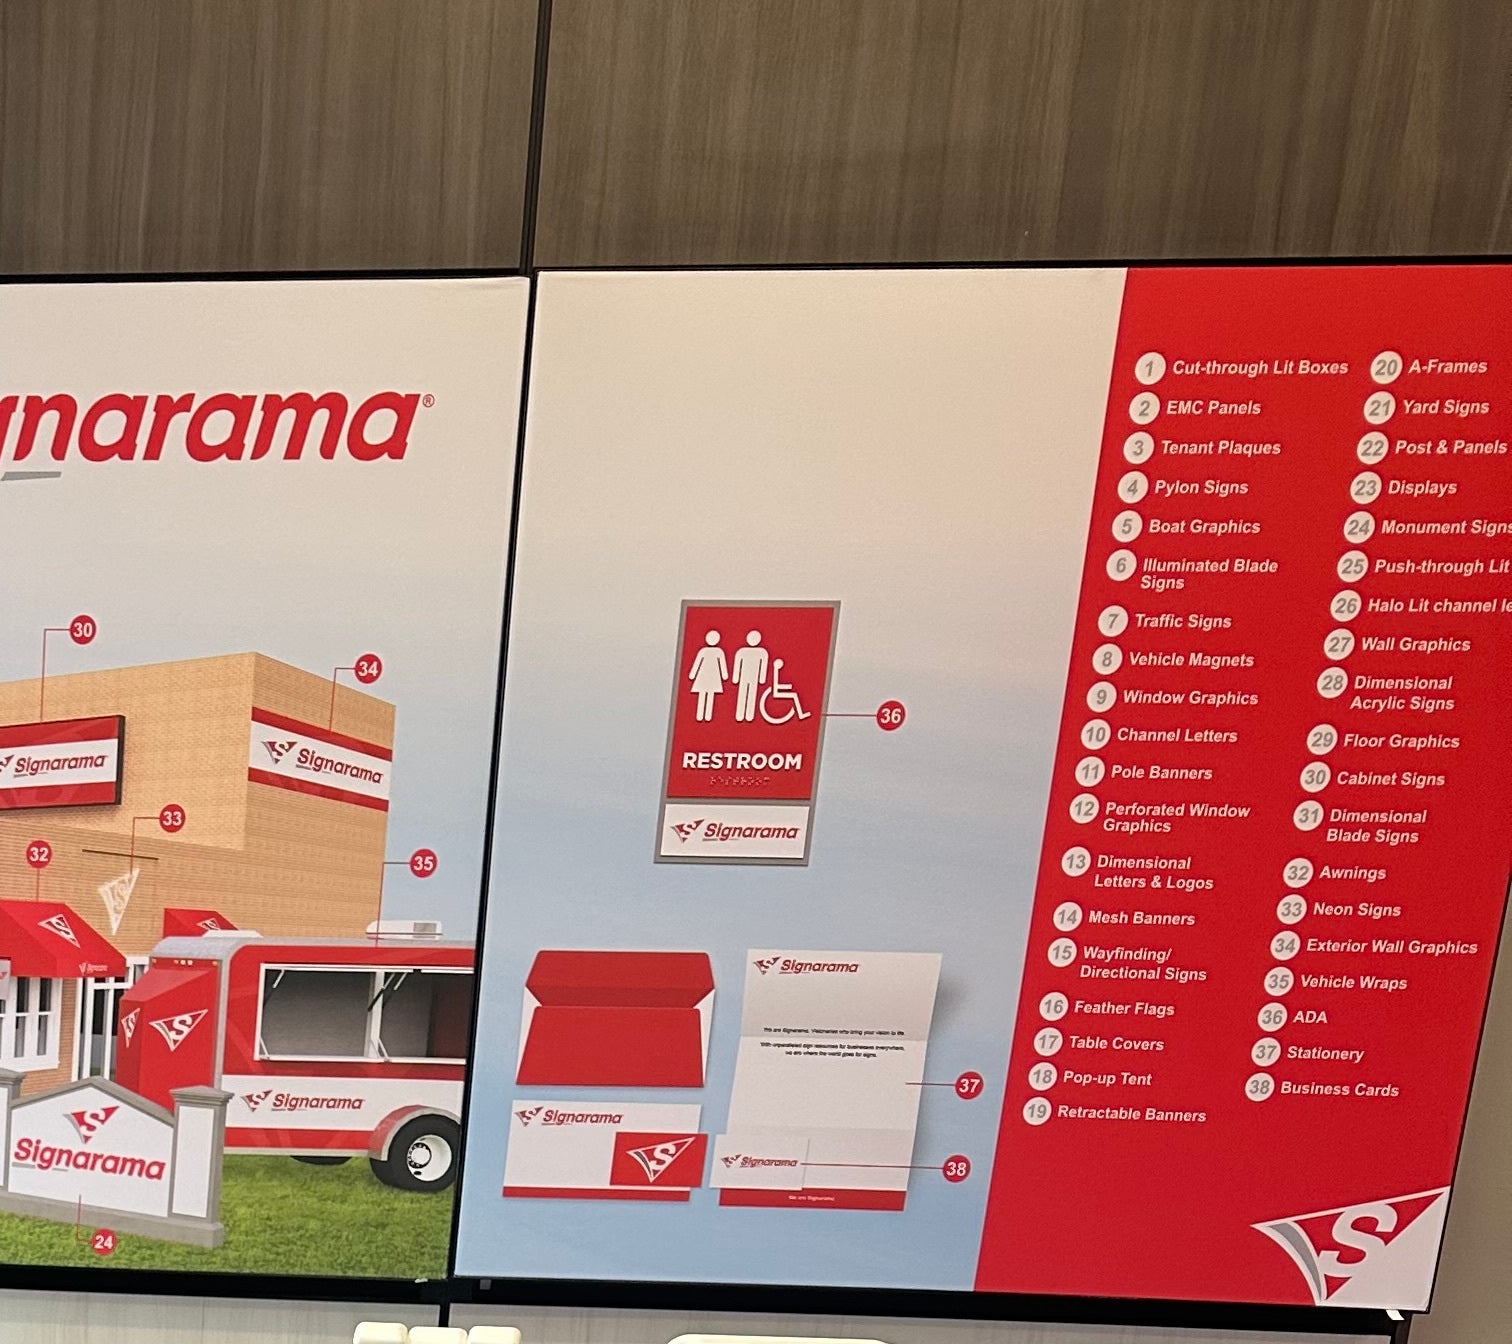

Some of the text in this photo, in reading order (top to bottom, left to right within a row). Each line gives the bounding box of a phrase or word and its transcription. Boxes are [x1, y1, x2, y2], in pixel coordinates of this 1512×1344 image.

[1173, 360, 1348, 378] Cut-through Lit Boxes
[1408, 359, 1487, 374] A-Frames
[1166, 400, 1261, 415] EMC Panels
[1403, 399, 1489, 417] Yard Signs
[1161, 440, 1281, 458] Tenant Plaques
[1395, 440, 1507, 454] Post & Panels
[1155, 480, 1248, 498] Pylon Signs
[1388, 480, 1457, 498] Displays
[1149, 519, 1260, 536] Boat Graphics
[1381, 519, 1512, 537] Monument Signs
[1143, 558, 1278, 573] Illuminated Blade
[1374, 559, 1510, 577] Push-through Lit
[1140, 575, 1184, 592] Signs
[1368, 598, 1497, 612] Halo Lit channel
[1135, 613, 1231, 631] Traffic Signs
[1362, 637, 1470, 654] Wall Graphics
[1130, 652, 1254, 670] Vehicle Magnets
[1354, 675, 1453, 690] Dimensional
[1124, 690, 1258, 708] Window Graphics
[1350, 696, 1454, 713] Acrylic Signs
[1117, 727, 1237, 742] Channel Letters
[1344, 734, 1460, 751] Floor Graphics
[14, 755, 108, 776] Signarama
[296, 748, 384, 784] Signarama
[683, 752, 803, 770] RESTROOM
[1111, 765, 1212, 780] Pole Banners
[1337, 771, 1445, 789] Cabinet Signs
[1105, 802, 1251, 817] Perforated Window
[1330, 809, 1427, 823] Dimensional
[703, 822, 799, 841] Signarama
[1103, 818, 1171, 835] Graphics
[1326, 828, 1418, 846] Blade Signs
[1097, 854, 1191, 869] Dimensional
[1319, 865, 1386, 883] Awnings
[1094, 874, 1213, 892] Letters & Logos
[1089, 910, 1195, 925] Mesh Banners
[1313, 902, 1401, 919] Neon Signs
[1084, 946, 1172, 964] Wayfinding/
[1307, 938, 1478, 956] Exterior Wall Graphics
[1080, 965, 1206, 983] Directional Signs
[1301, 974, 1407, 992] Vehicle Wraps
[1074, 1000, 1174, 1018] Feather Flags
[1293, 1010, 1327, 1023] ADA
[1069, 1036, 1164, 1051] Table Covers
[1287, 1046, 1365, 1063] Stationery
[1063, 1070, 1152, 1087] Pop-up Tent
[1281, 1081, 1399, 1097] Business Cards
[272, 1093, 363, 1111] Signarama
[1058, 1105, 1206, 1122] Retractable Banners
[14, 1137, 166, 1181] Signarama
